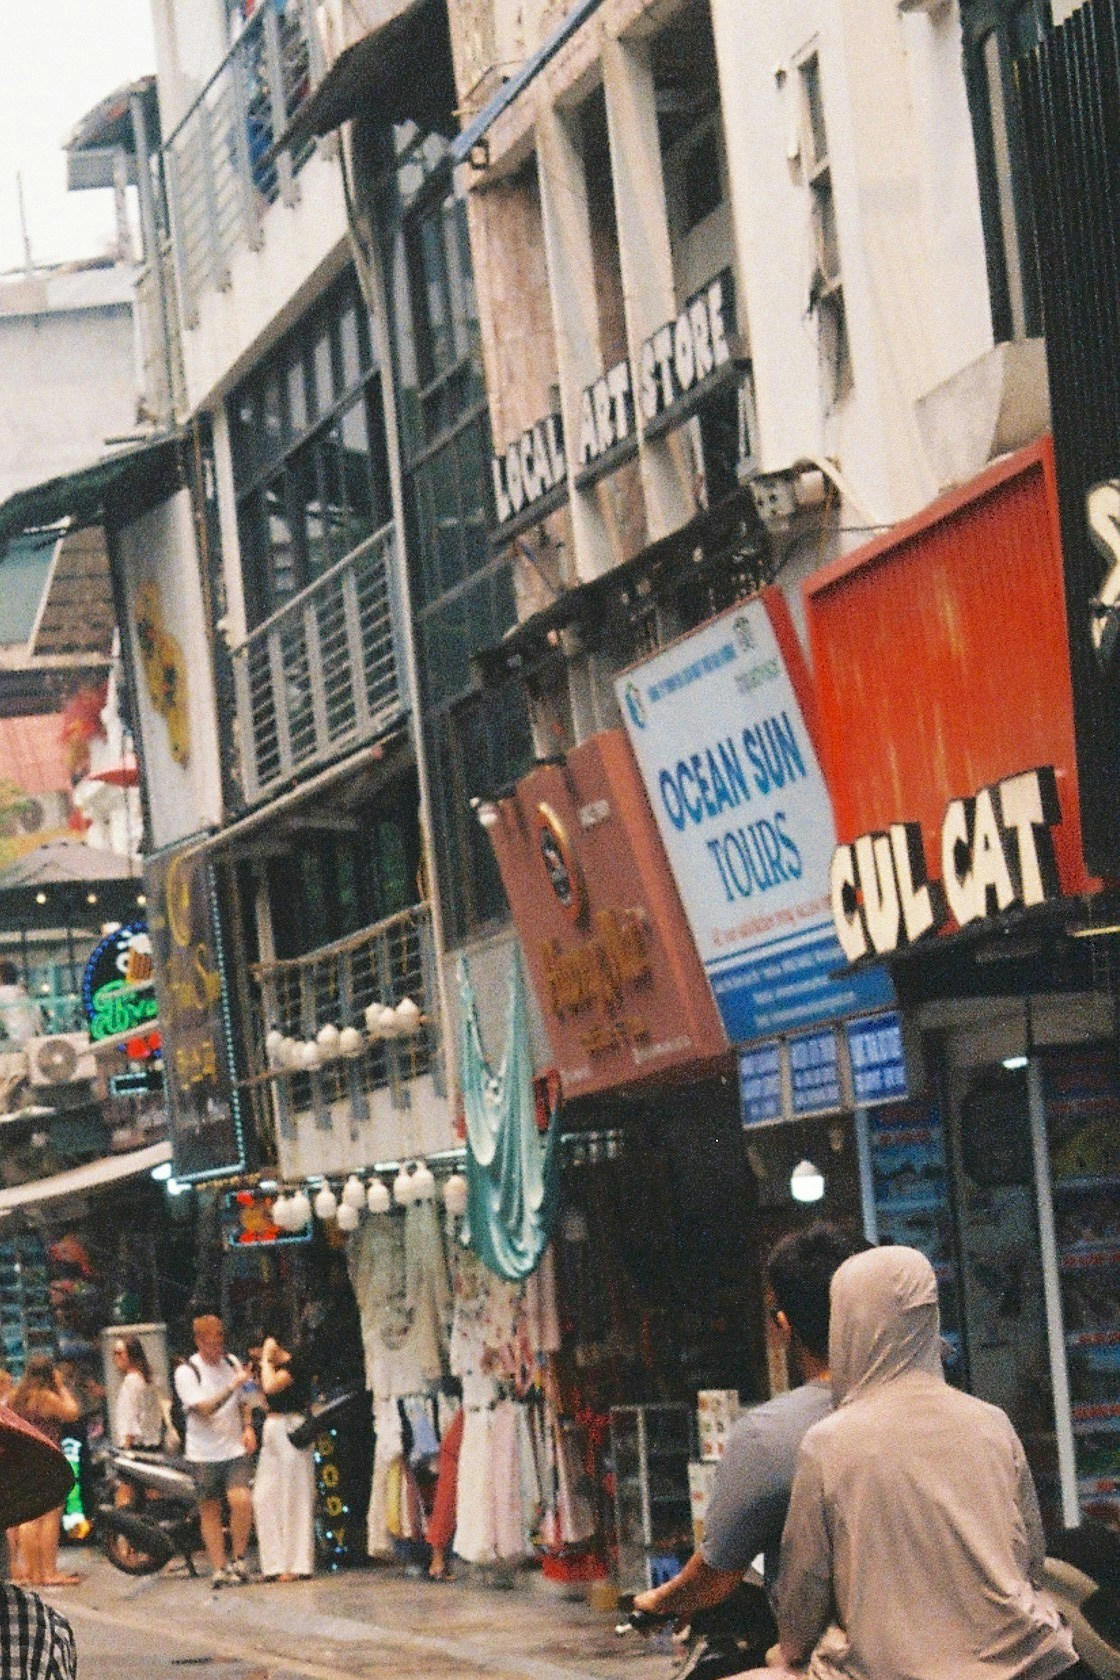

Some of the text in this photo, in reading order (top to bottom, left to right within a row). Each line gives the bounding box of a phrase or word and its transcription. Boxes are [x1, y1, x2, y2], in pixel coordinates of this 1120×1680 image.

[491, 417, 566, 524] LOCAL
[579, 361, 628, 465] ART
[640, 278, 730, 419] STORE
[658, 710, 808, 832] OCEAN SUN
[706, 810, 804, 902] TOURS
[830, 771, 1046, 963] CUL CAT
